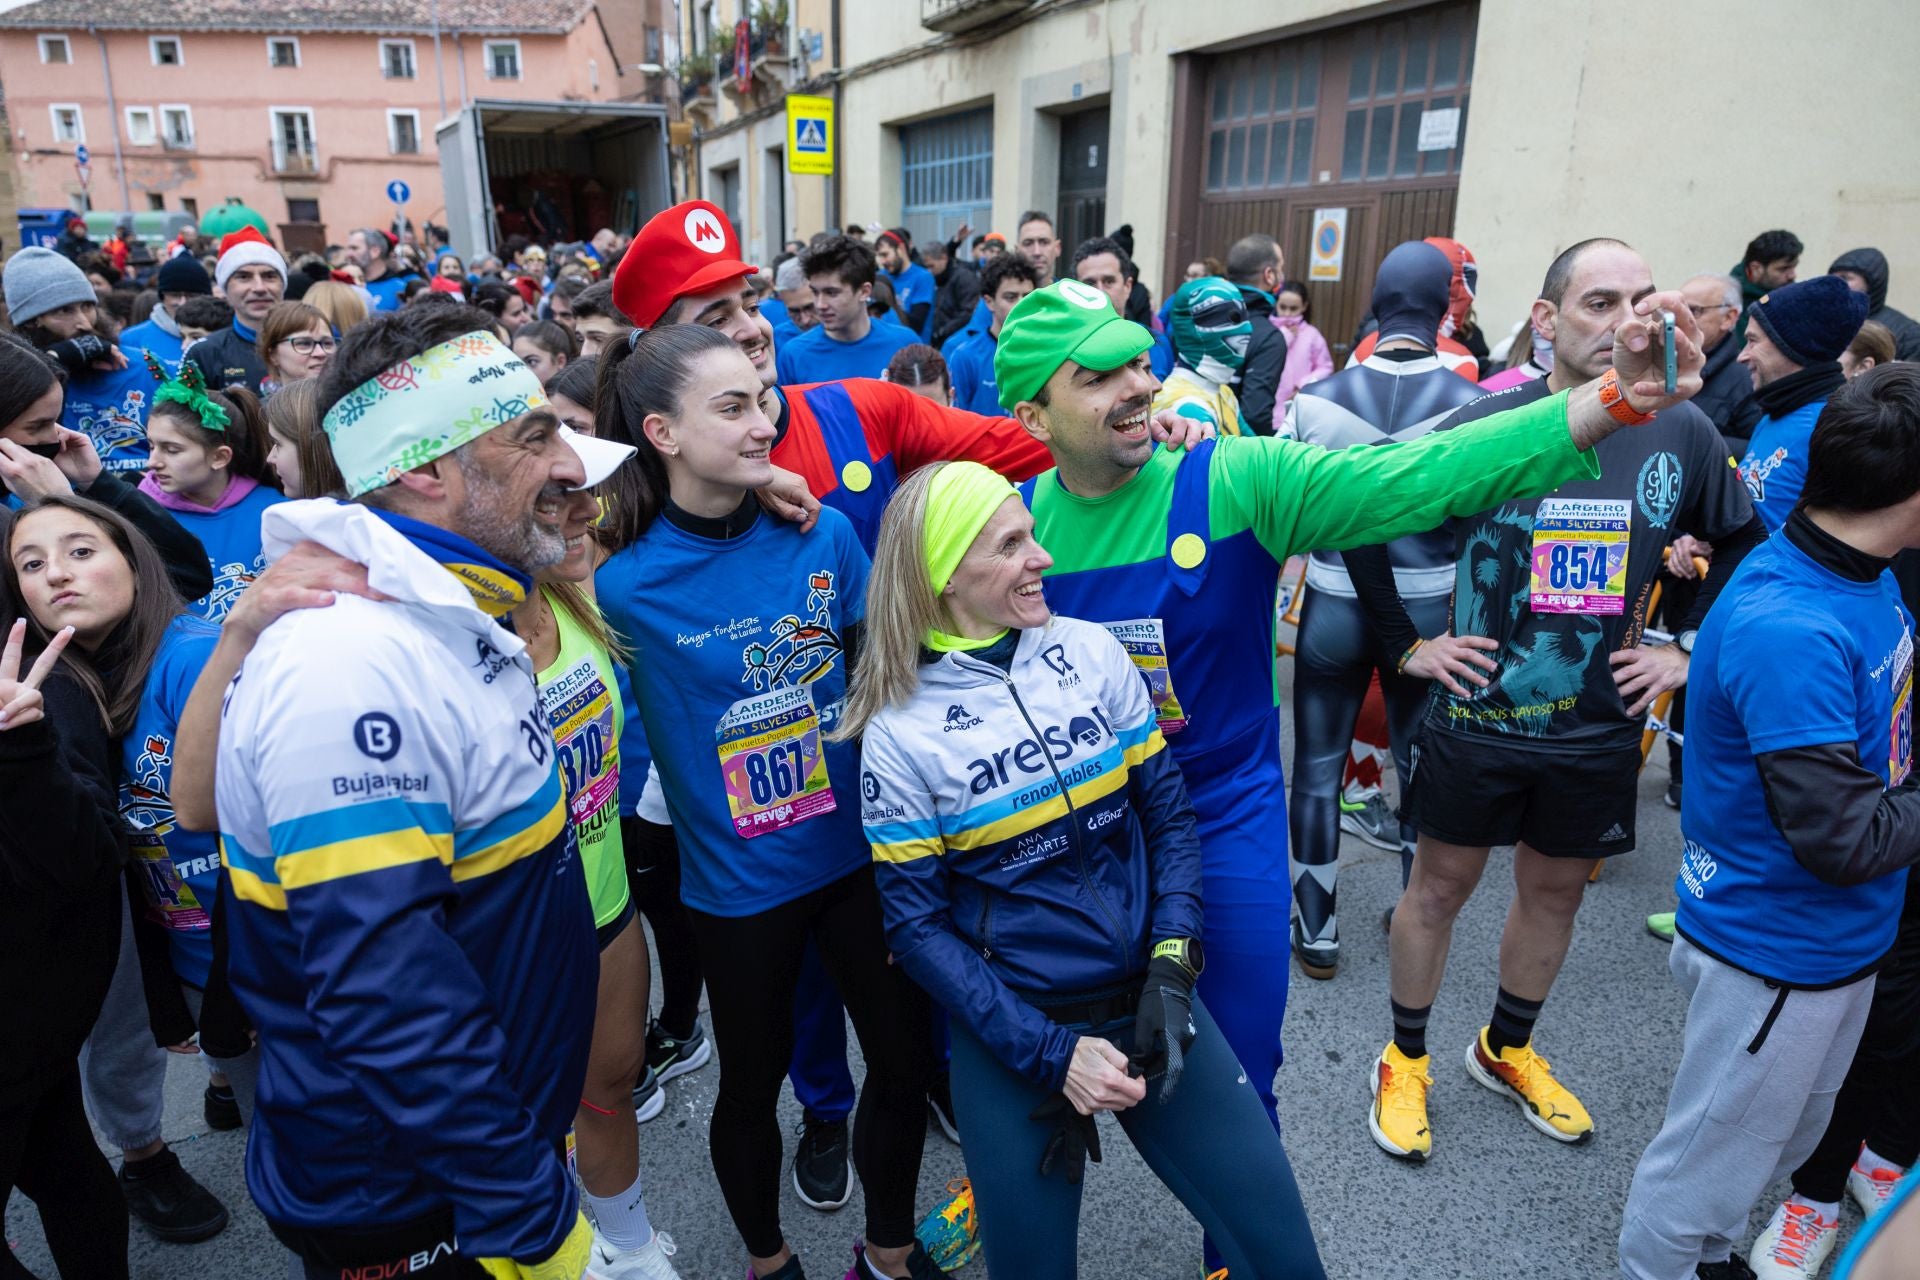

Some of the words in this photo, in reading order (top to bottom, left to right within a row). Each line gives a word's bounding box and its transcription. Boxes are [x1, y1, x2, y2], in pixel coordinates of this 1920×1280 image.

[696, 220, 720, 242] M
[1542, 520, 1562, 528] SAN
[1554, 531, 1576, 539] vuelta
[1578, 532, 1606, 541] Popular
[1549, 544, 1608, 591] 854
[1548, 595, 1585, 607] PEVISA
[713, 616, 760, 637] fondistas
[729, 632, 738, 640] de
[542, 662, 591, 701] RDERO
[545, 670, 597, 709] ntamiento
[729, 688, 805, 718] LARDERO
[730, 695, 808, 725] ayuntamiento
[1558, 696, 1578, 712] REY
[570, 707, 594, 729] Popular
[363, 720, 393, 754] B
[719, 742, 739, 755] XVIII
[740, 736, 765, 749] vuelta
[767, 727, 795, 742] Popular
[723, 727, 747, 740] SAN
[746, 740, 806, 805] 867
[1012, 760, 1103, 810] renovables
[571, 791, 594, 815] VISA
[753, 803, 794, 825] PEVISA
[1018, 833, 1043, 850] ANA
[1679, 853, 1705, 899] miento
